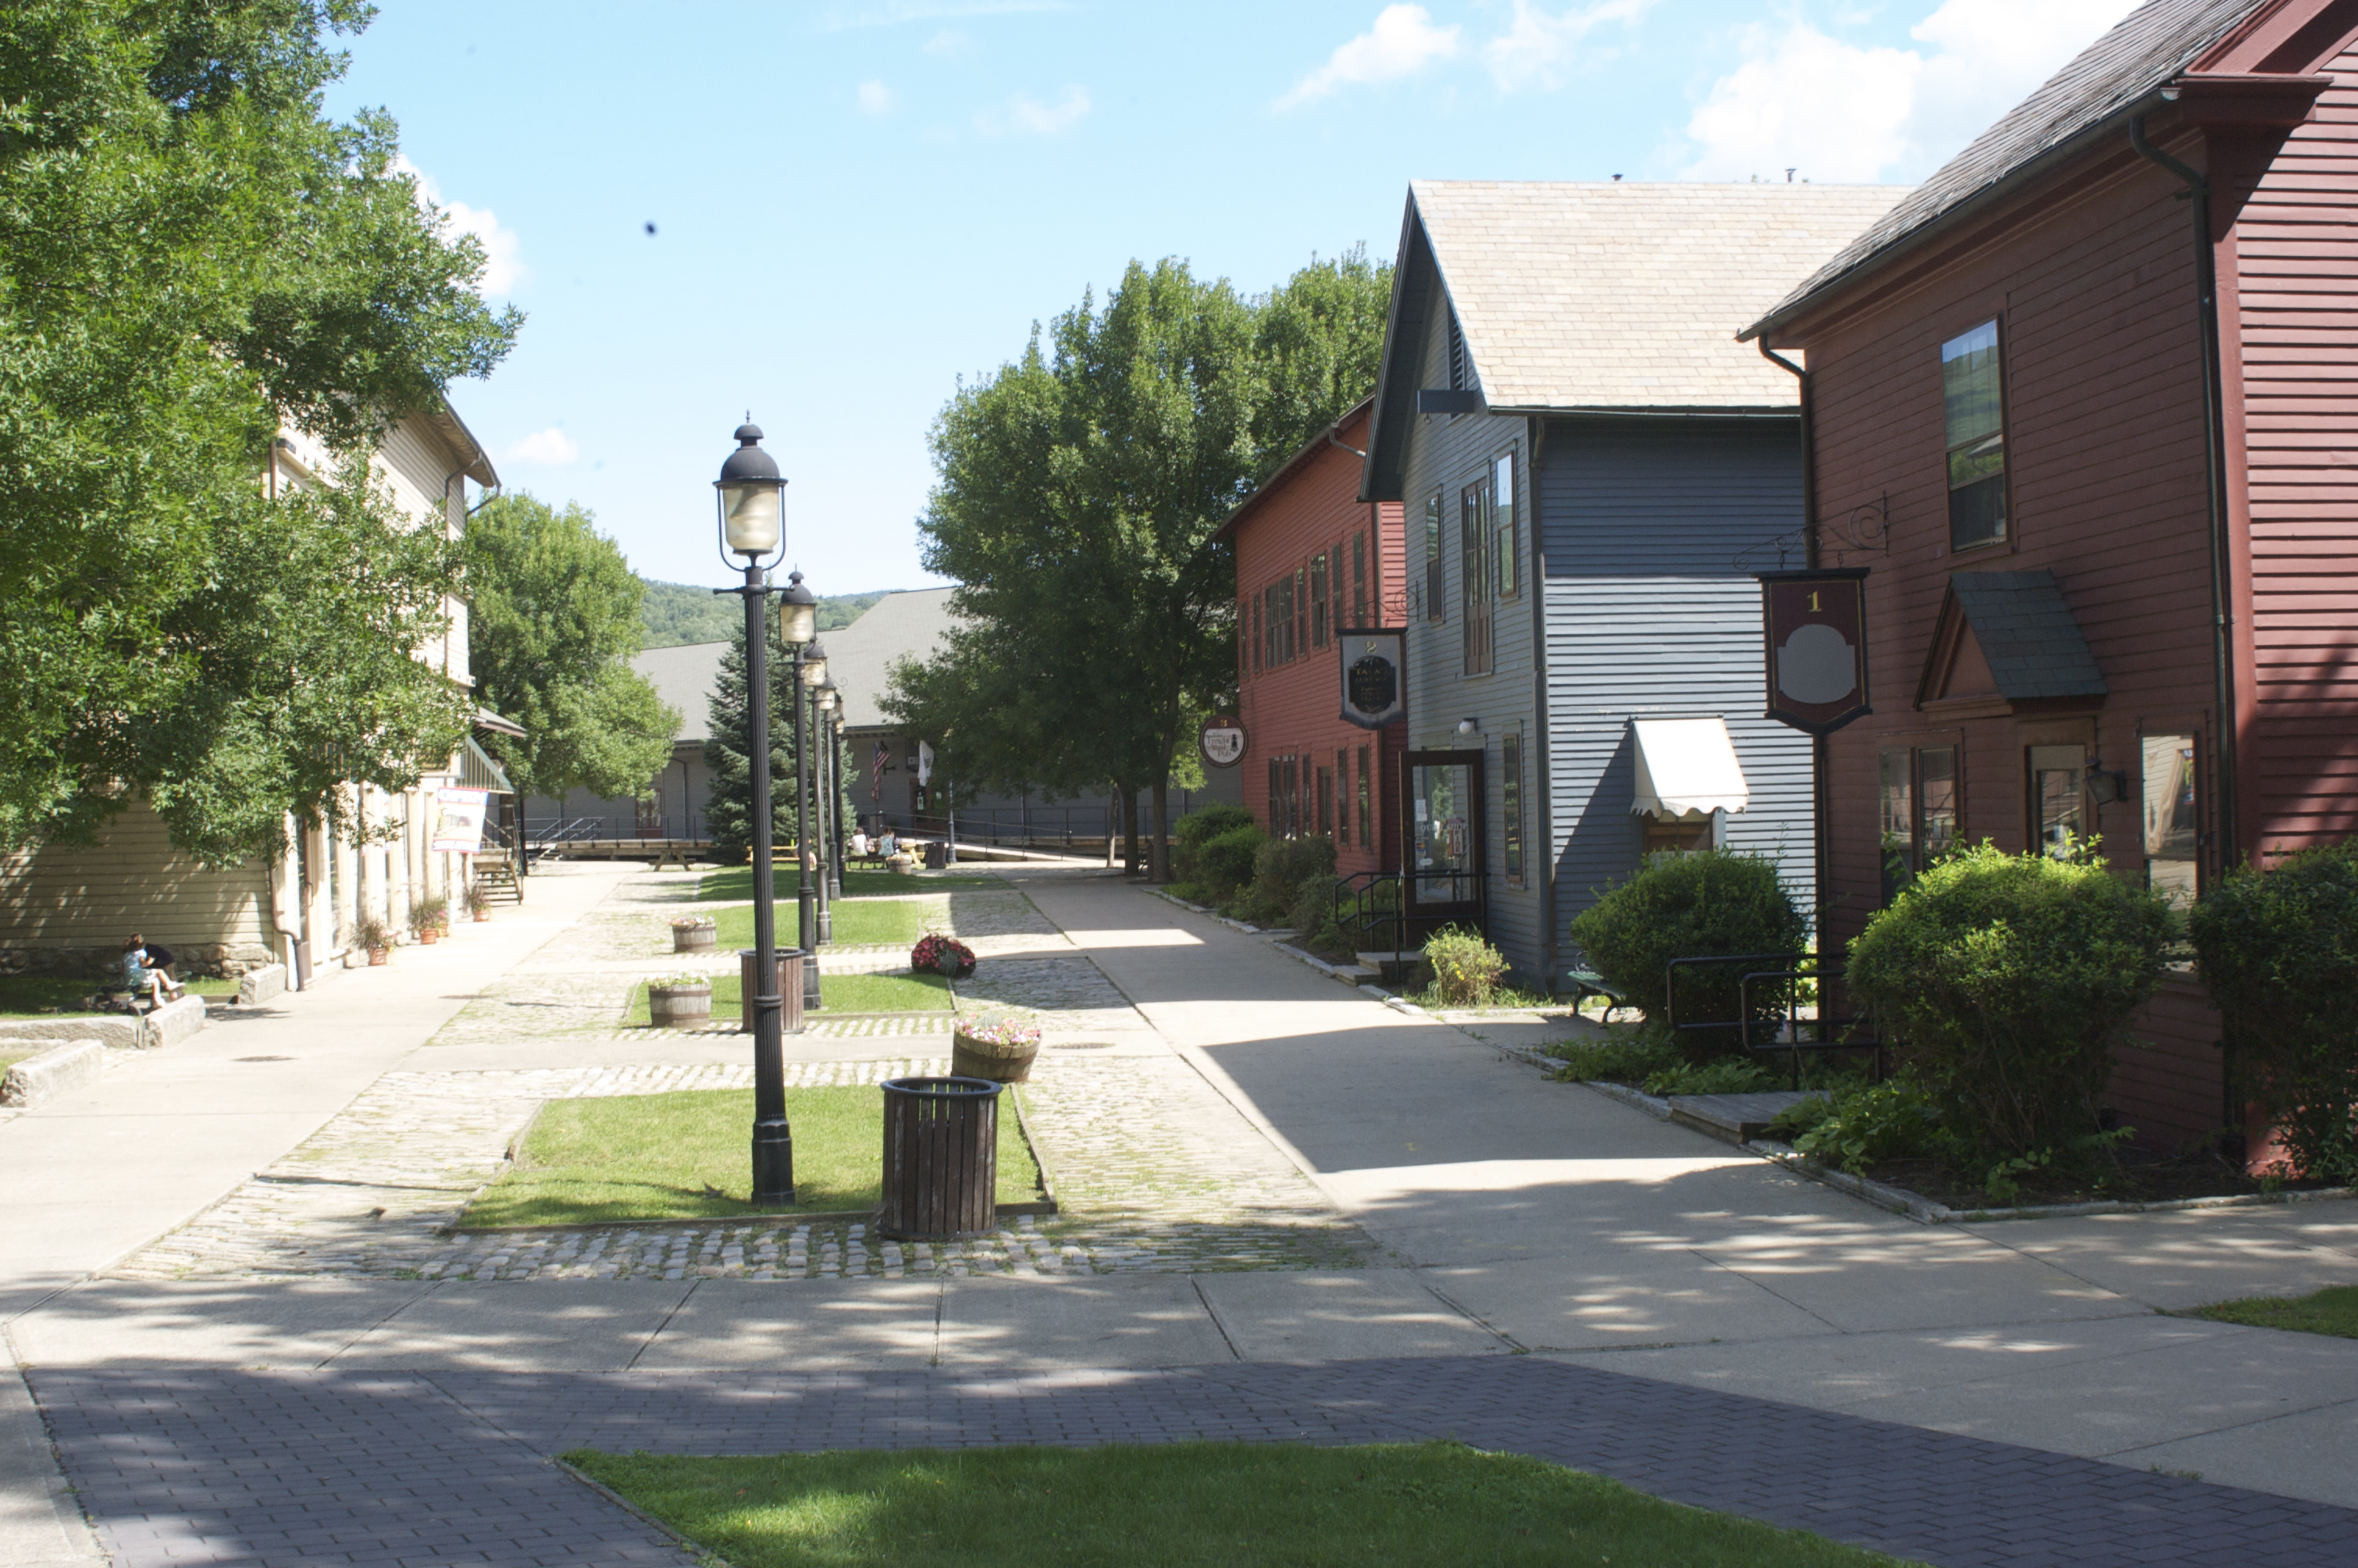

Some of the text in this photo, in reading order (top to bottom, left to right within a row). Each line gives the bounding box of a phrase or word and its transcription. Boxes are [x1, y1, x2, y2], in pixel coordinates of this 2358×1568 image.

[1807, 590, 1822, 612] 1
[1365, 640, 1377, 654] 2
[1220, 718, 1228, 728] 3
